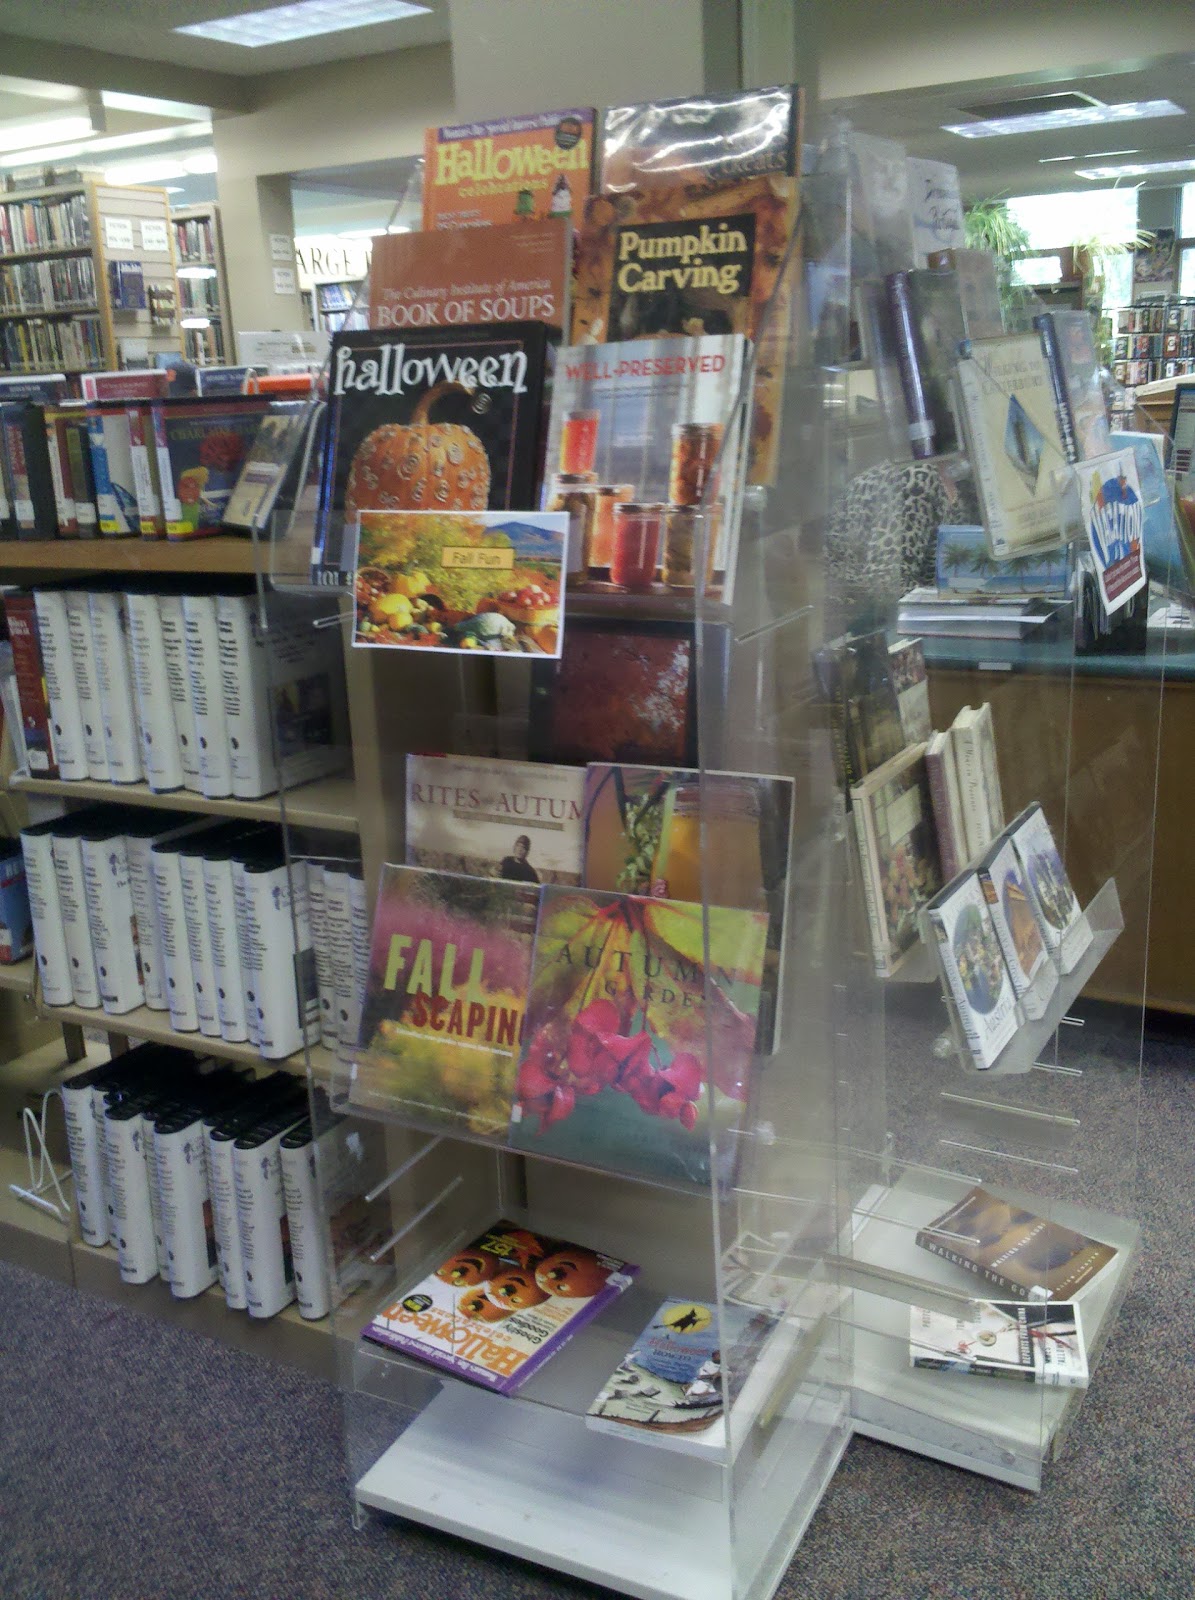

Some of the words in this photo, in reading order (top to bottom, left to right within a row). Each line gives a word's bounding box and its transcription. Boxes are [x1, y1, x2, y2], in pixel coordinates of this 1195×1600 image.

[434, 138, 589, 186] Halloween
[295, 247, 356, 276] ARGE
[618, 222, 748, 264] Pumpkin
[617, 257, 743, 294] Carving
[377, 301, 440, 327] BOOK
[444, 299, 475, 323] OF
[479, 294, 556, 321] SOUPS
[332, 342, 528, 396] halloween
[452, 551, 472, 565] Fall
[477, 552, 501, 565] Fun
[411, 783, 482, 809] RITES
[495, 792, 582, 821] AUTUM
[383, 933, 489, 1007] FALL
[555, 943, 737, 986] AUTUMN
[604, 976, 712, 1008] GARDE
[412, 990, 526, 1047] SCAPIN
[928, 1243, 979, 1273] WALKING
[984, 1270, 1005, 1287] THE
[1010, 1283, 1027, 1297] GO
[379, 1304, 530, 1377] Halloween
[504, 1324, 542, 1345] Ghostly
